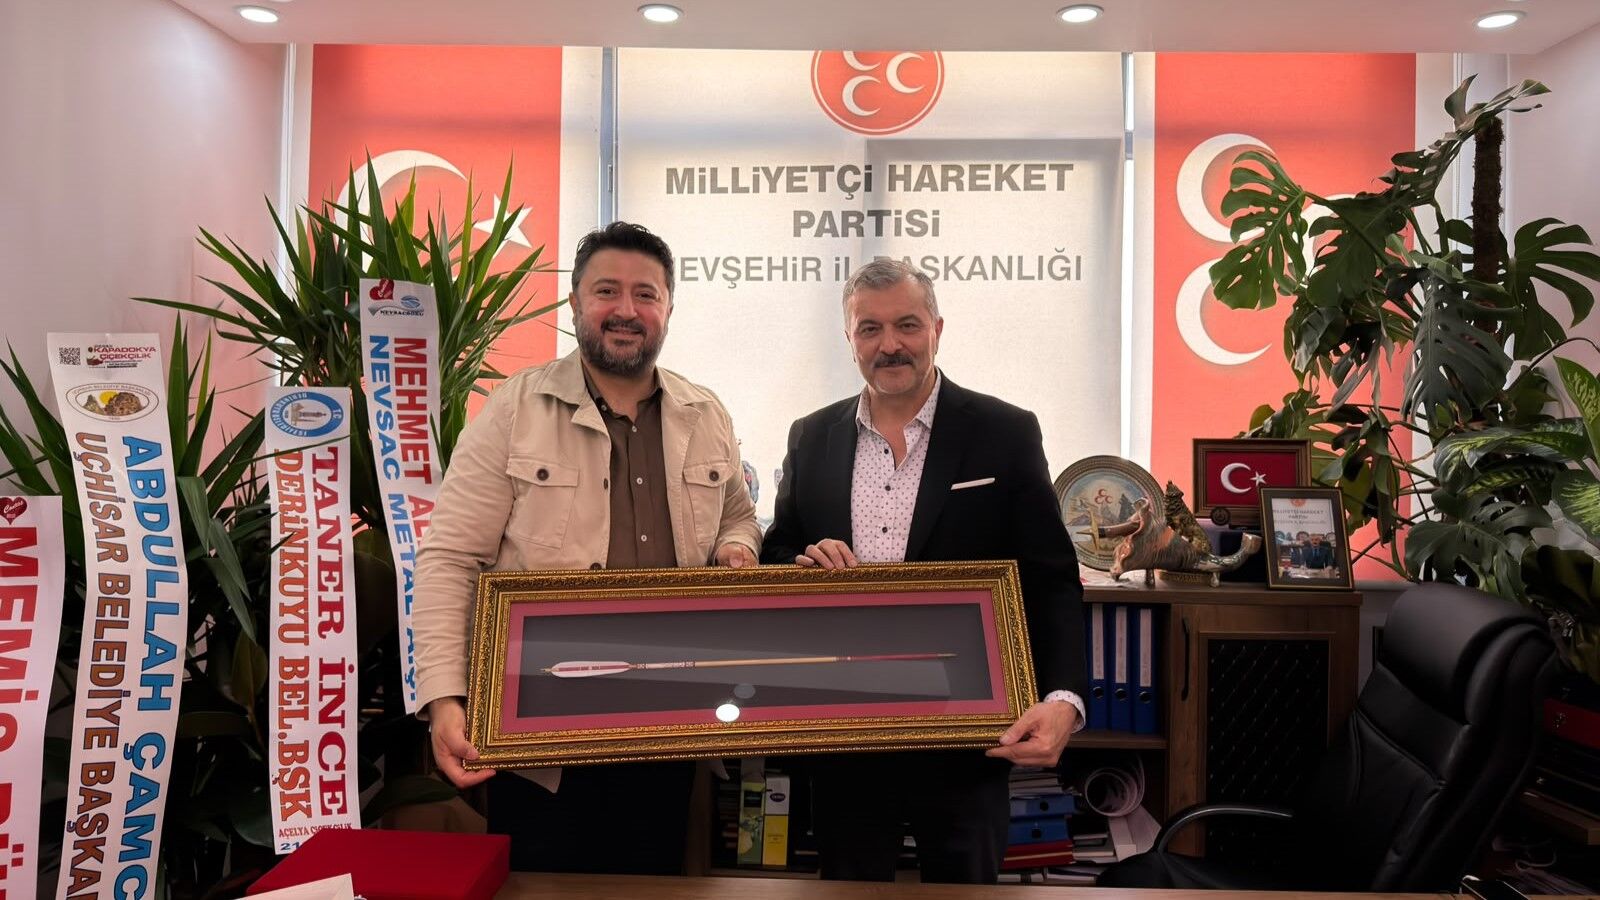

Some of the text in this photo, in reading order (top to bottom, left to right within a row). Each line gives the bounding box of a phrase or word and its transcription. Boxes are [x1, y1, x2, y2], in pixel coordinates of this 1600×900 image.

[888, 163, 1075, 192] HAREKET
[369, 335, 400, 481] NEVSAC
[394, 337, 432, 485] MEHMET
[73, 432, 129, 564] UÇHİSAR
[122, 436, 180, 711] ABDULLAH
[312, 446, 355, 817] TANER İNCE
[83, 573, 131, 750] BELEDİYE
